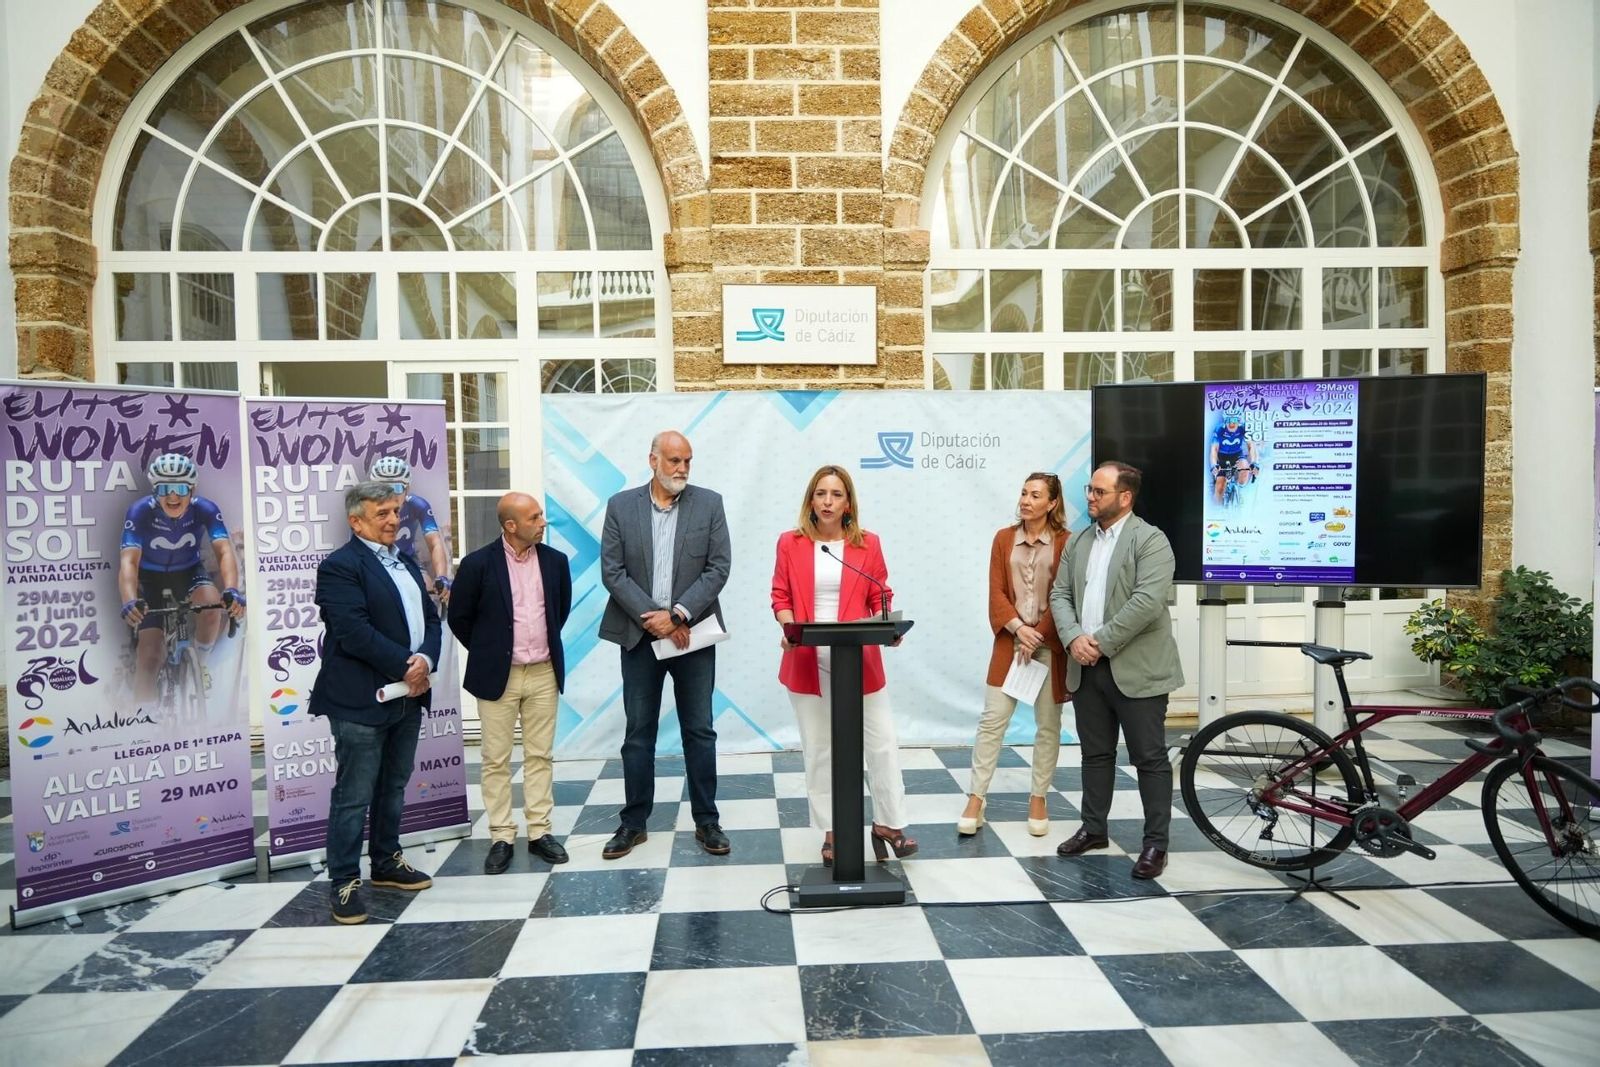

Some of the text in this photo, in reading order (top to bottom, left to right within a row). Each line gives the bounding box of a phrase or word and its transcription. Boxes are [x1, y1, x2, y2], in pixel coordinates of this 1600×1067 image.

[795, 308, 869, 326] Diputación
[795, 328, 855, 343] de Cádiz
[3, 389, 150, 422] ELITE
[1208, 397, 1270, 412] WOMEN
[1312, 401, 1354, 416] 2024
[250, 403, 371, 432] ELITE
[1244, 411, 1280, 421] RUTA
[1244, 421, 1270, 432] DEL
[7, 418, 230, 474] WOMEN
[920, 432, 1000, 450] Diputación
[1243, 431, 1270, 442] SOL
[255, 427, 438, 474] WOMEN
[921, 453, 986, 469] de Cádiz
[5, 459, 138, 493] RUTA
[255, 464, 360, 494] RUTA
[6, 495, 97, 528] DEL
[255, 494, 329, 524] DEL
[6, 528, 102, 563] SOL
[257, 524, 335, 555] SOL
[7, 562, 112, 575] VUELTA CICLISTA
[258, 555, 298, 564] VUELTA
[258, 562, 321, 573] A ANDALUC
[7, 570, 93, 585] A ANDALUCÍA
[17, 589, 96, 607] 29Mayo
[276, 592, 286, 605] 2
[30, 607, 39, 622] 1
[44, 603, 97, 624] Junio
[266, 606, 323, 631] 202
[15, 620, 101, 652] 2024
[63, 708, 158, 736] Andalucía
[428, 708, 457, 719] ETAPA
[1430, 711, 1465, 719] Navarro
[432, 720, 457, 739] LA
[114, 743, 171, 760] LLEGADA
[174, 740, 189, 751] DE
[206, 732, 243, 746] ETAPA
[420, 755, 461, 772] MAYO
[43, 750, 224, 799] ALCALÁ DEL
[160, 778, 239, 803] 29 MAYO
[43, 788, 141, 826] VALLE
